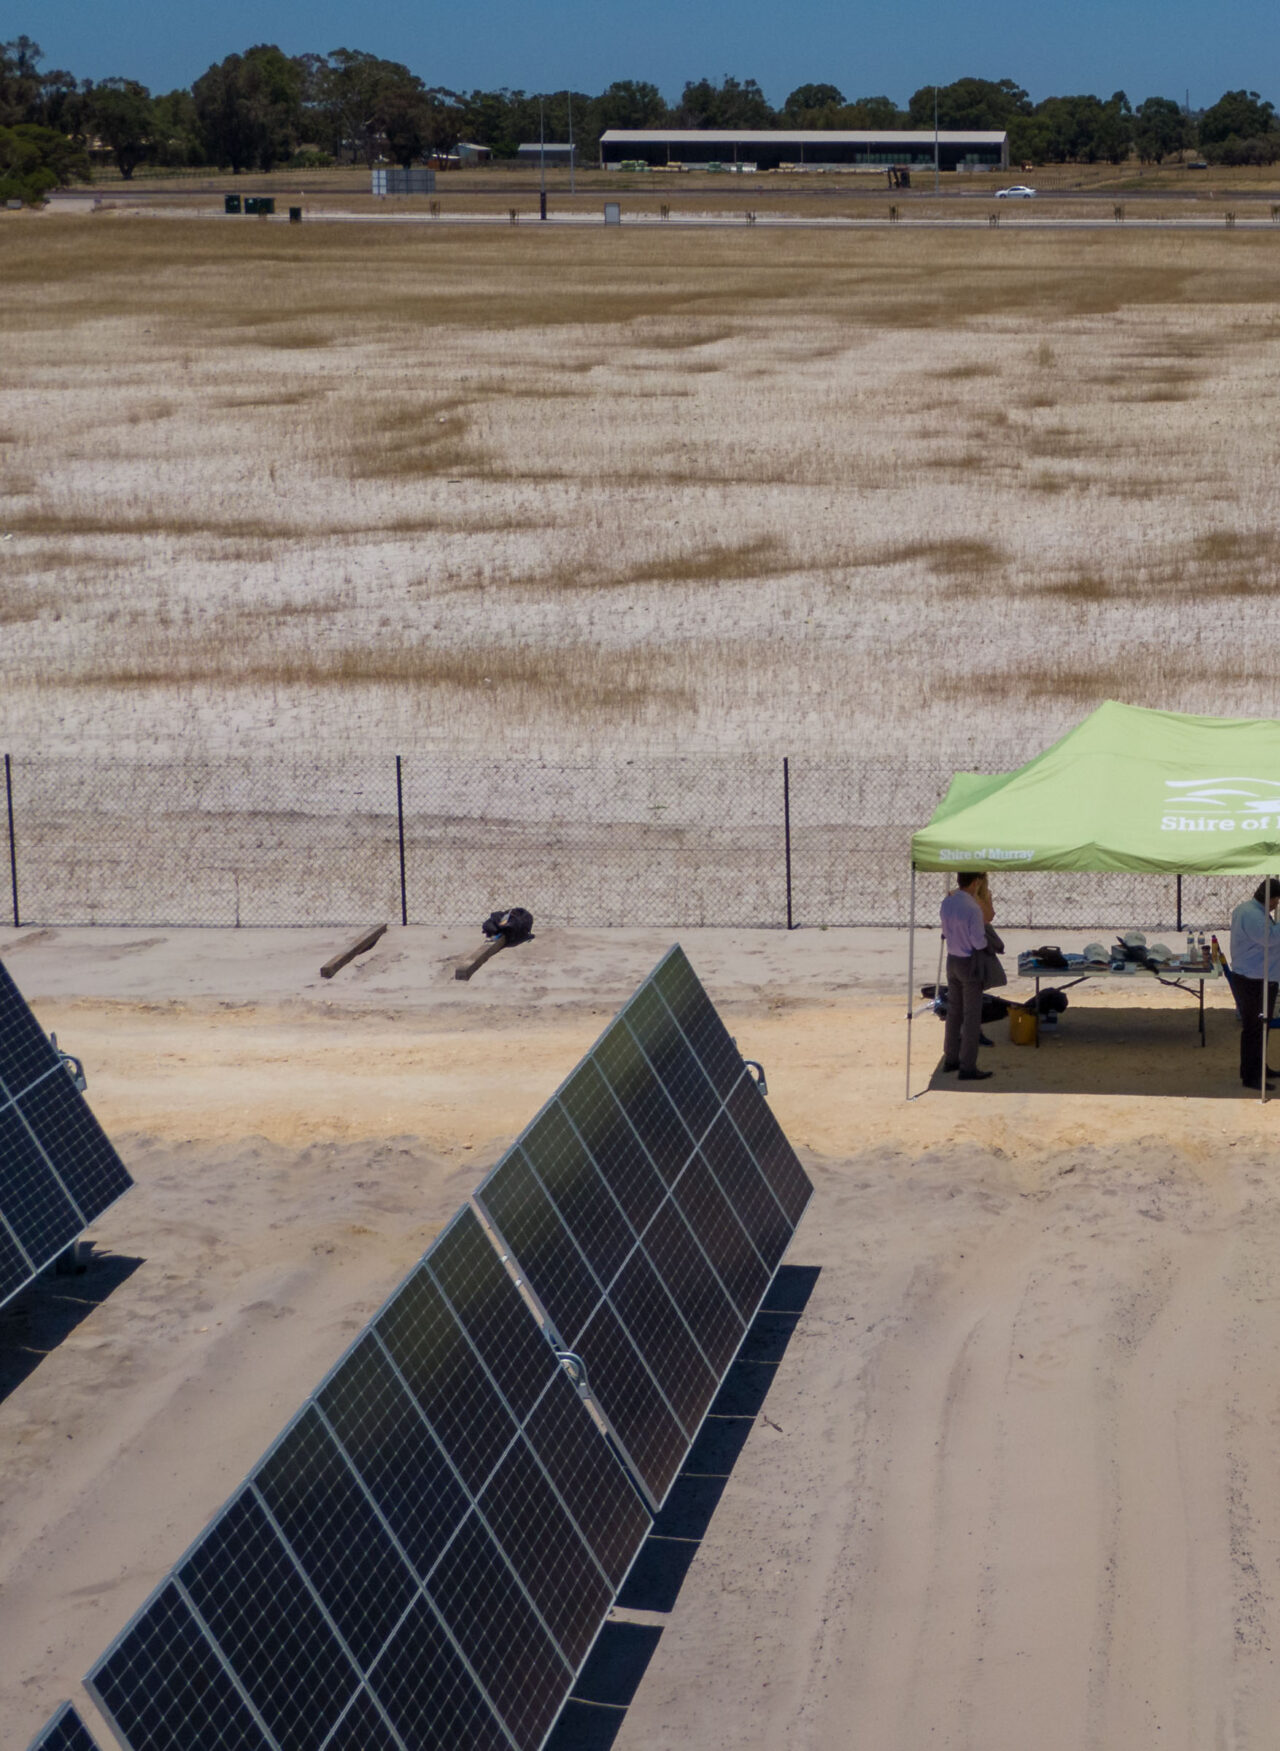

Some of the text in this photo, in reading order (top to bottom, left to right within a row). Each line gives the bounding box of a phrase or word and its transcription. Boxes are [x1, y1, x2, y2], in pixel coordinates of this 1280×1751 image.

[1160, 816, 1235, 832] Shire
[1241, 816, 1270, 830] of
[940, 847, 1035, 863] Shire of Murray
